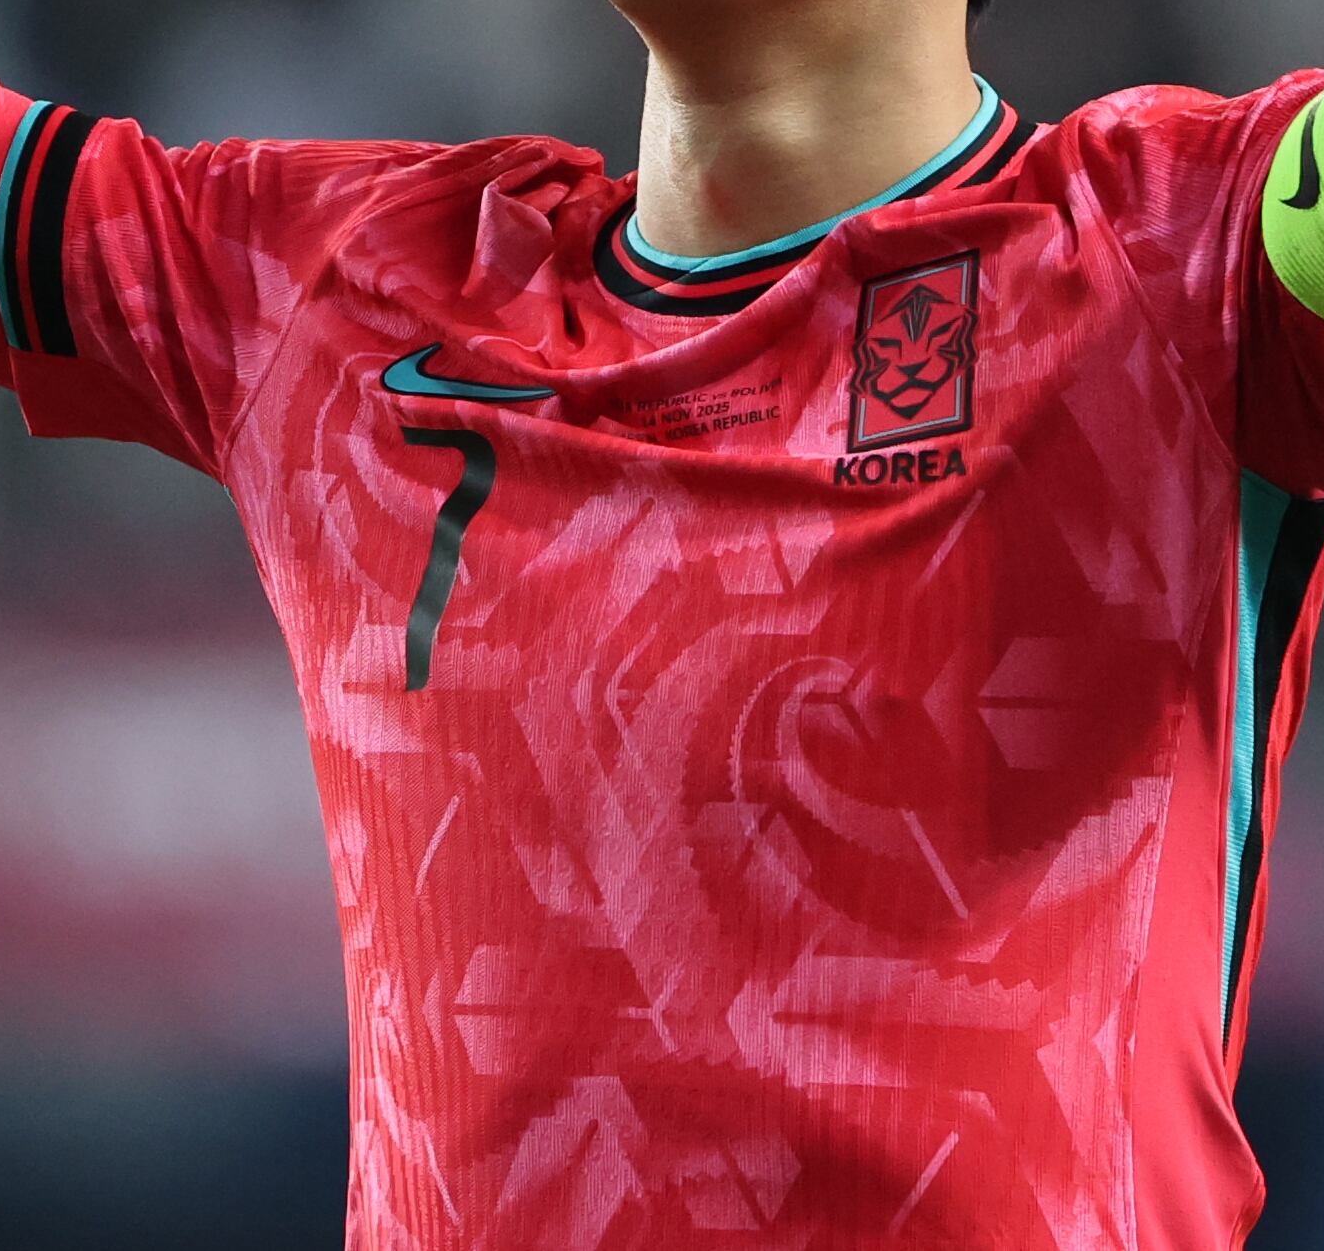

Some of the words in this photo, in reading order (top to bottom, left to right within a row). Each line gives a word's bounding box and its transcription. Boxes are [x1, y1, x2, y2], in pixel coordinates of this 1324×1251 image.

[637, 392, 707, 414] REPUBLIC
[661, 408, 692, 425] NOV
[697, 401, 730, 418] 2025
[666, 422, 709, 442] KOREA
[713, 405, 781, 432] REPUBLIC
[833, 447, 967, 487] KOREA
[401, 426, 497, 692] 7
